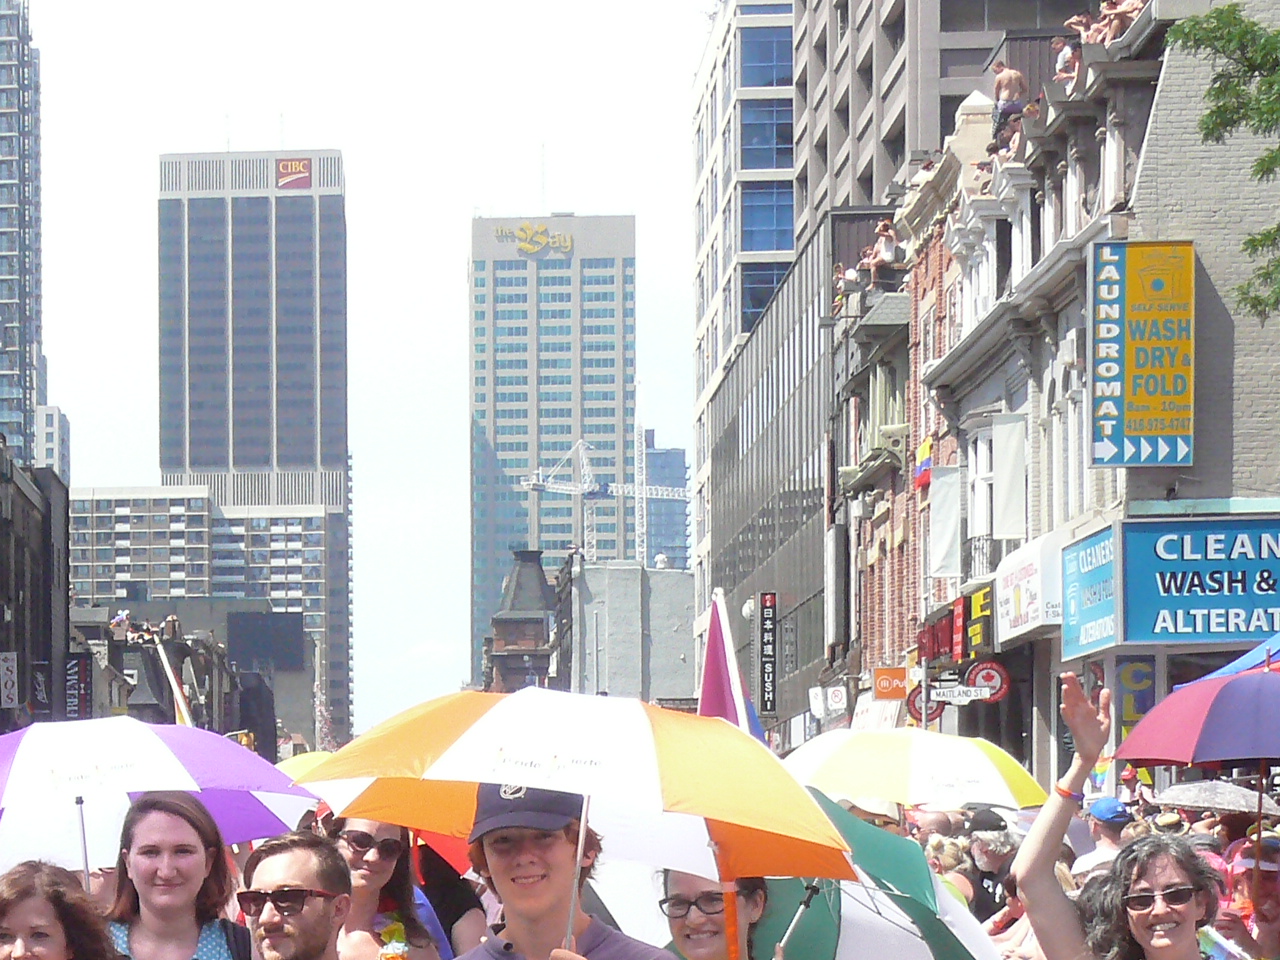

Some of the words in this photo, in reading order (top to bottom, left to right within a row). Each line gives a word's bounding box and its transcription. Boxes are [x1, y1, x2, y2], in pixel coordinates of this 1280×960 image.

[278, 160, 308, 174] CIBC
[1131, 303, 1155, 312] SELF
[1157, 303, 1189, 312] SERVE
[1095, 246, 1121, 436] LAUNDROMAT
[1128, 318, 1192, 341] WASH
[1135, 347, 1179, 369] DRY
[1181, 353, 1192, 367] &
[1131, 374, 1188, 397] FOLD
[1127, 402, 1150, 412] 8am
[1161, 401, 1192, 414] 10pm
[1078, 537, 1114, 574] CLEANERS
[1154, 533, 1280, 561] CLEAN
[1156, 569, 1248, 596] WASH
[1253, 569, 1278, 595] &
[763, 608, 773, 655] 日本料理
[1081, 615, 1114, 644] ALTERATIONS
[5, 665, 15, 704] SOS
[66, 659, 78, 718] FREEMAN
[764, 663, 773, 710] SUSHI
[935, 688, 971, 699] MAITLAND
